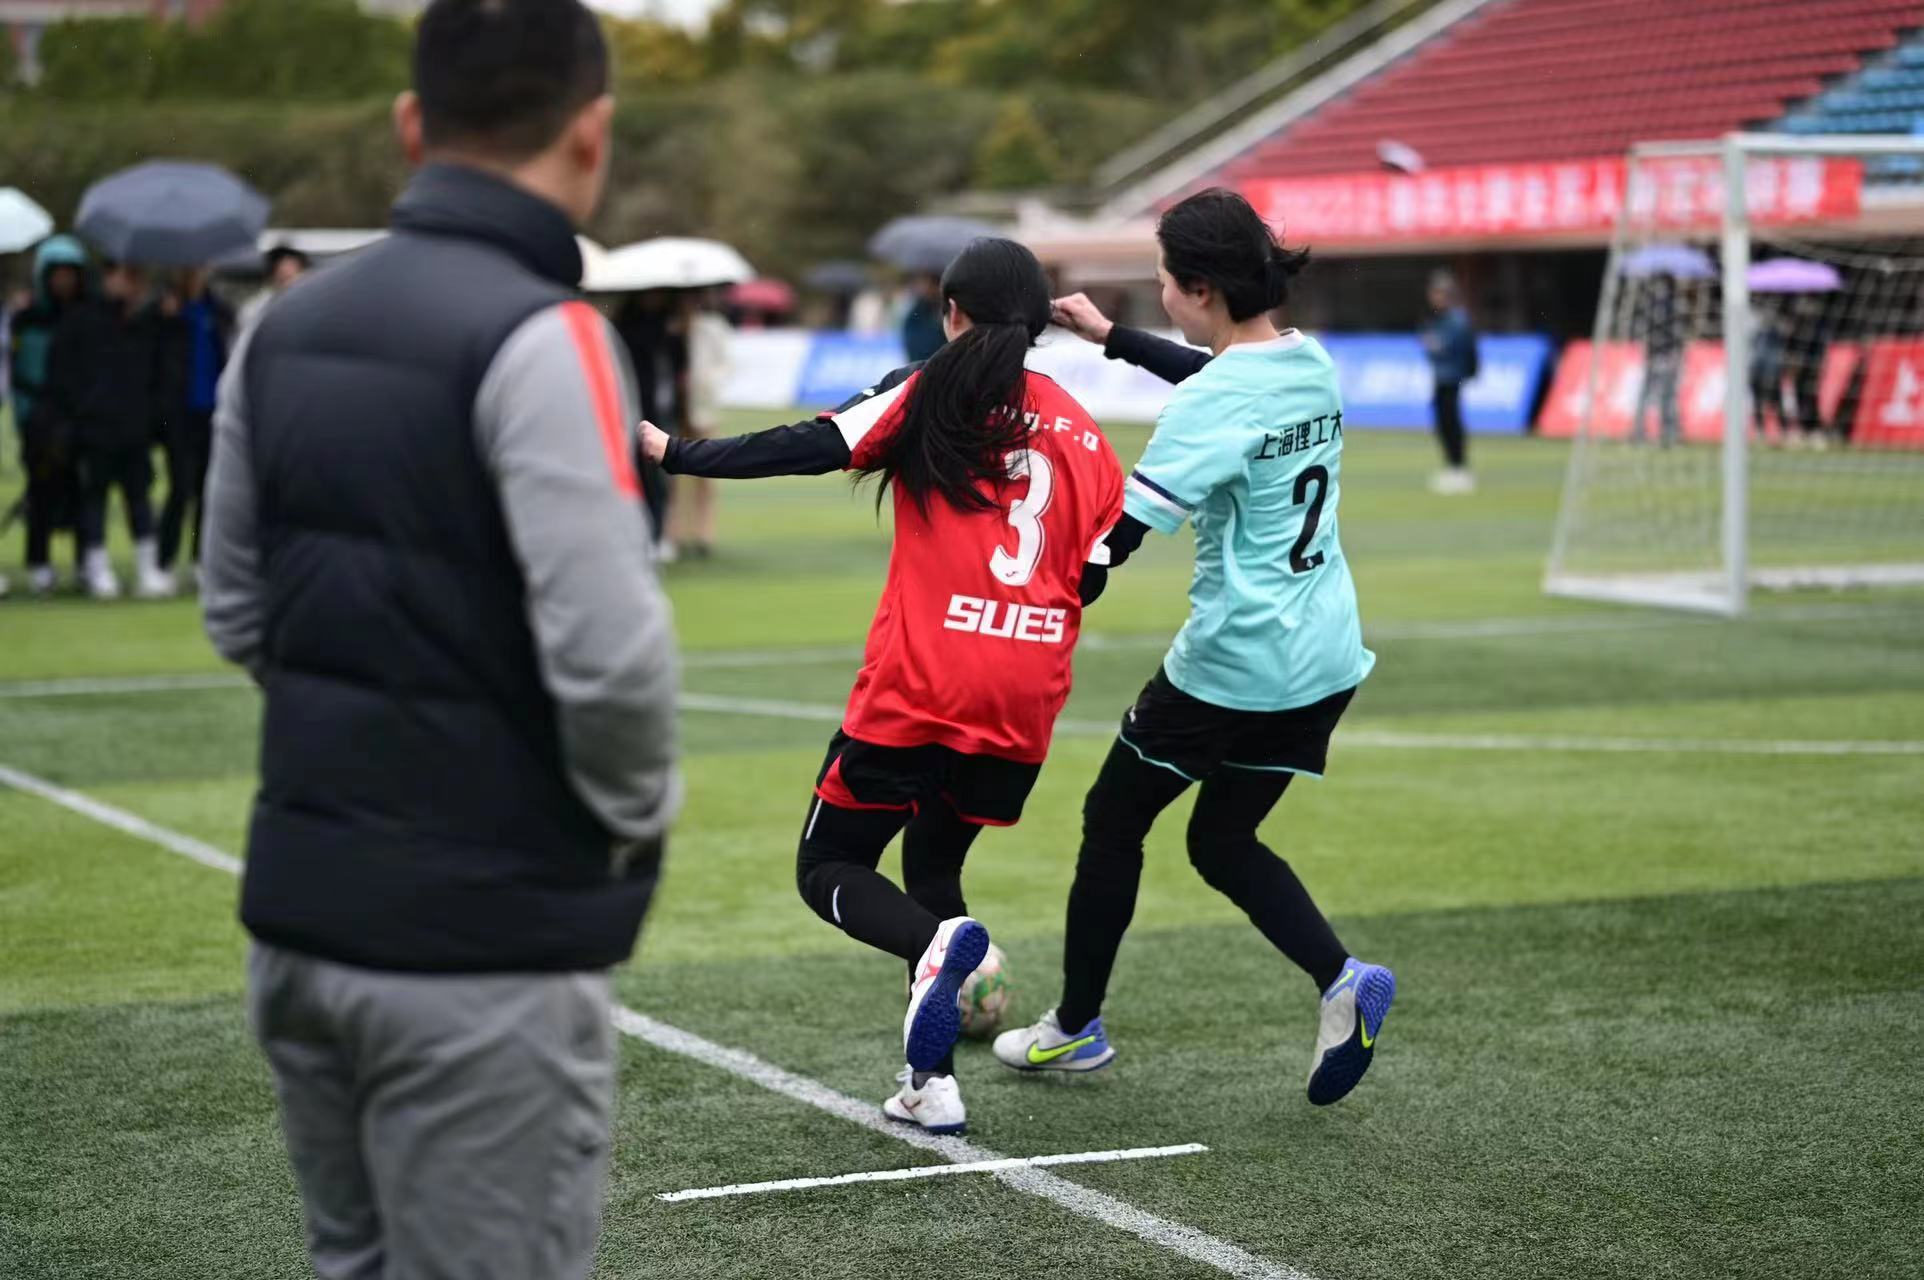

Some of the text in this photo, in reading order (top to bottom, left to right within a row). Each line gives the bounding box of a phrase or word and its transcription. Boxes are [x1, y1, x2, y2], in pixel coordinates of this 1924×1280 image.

[1254, 410, 1343, 460] 上海理工大
[988, 447, 1055, 587] 3
[1289, 464, 1329, 574] 2
[943, 593, 1066, 643] SUES
